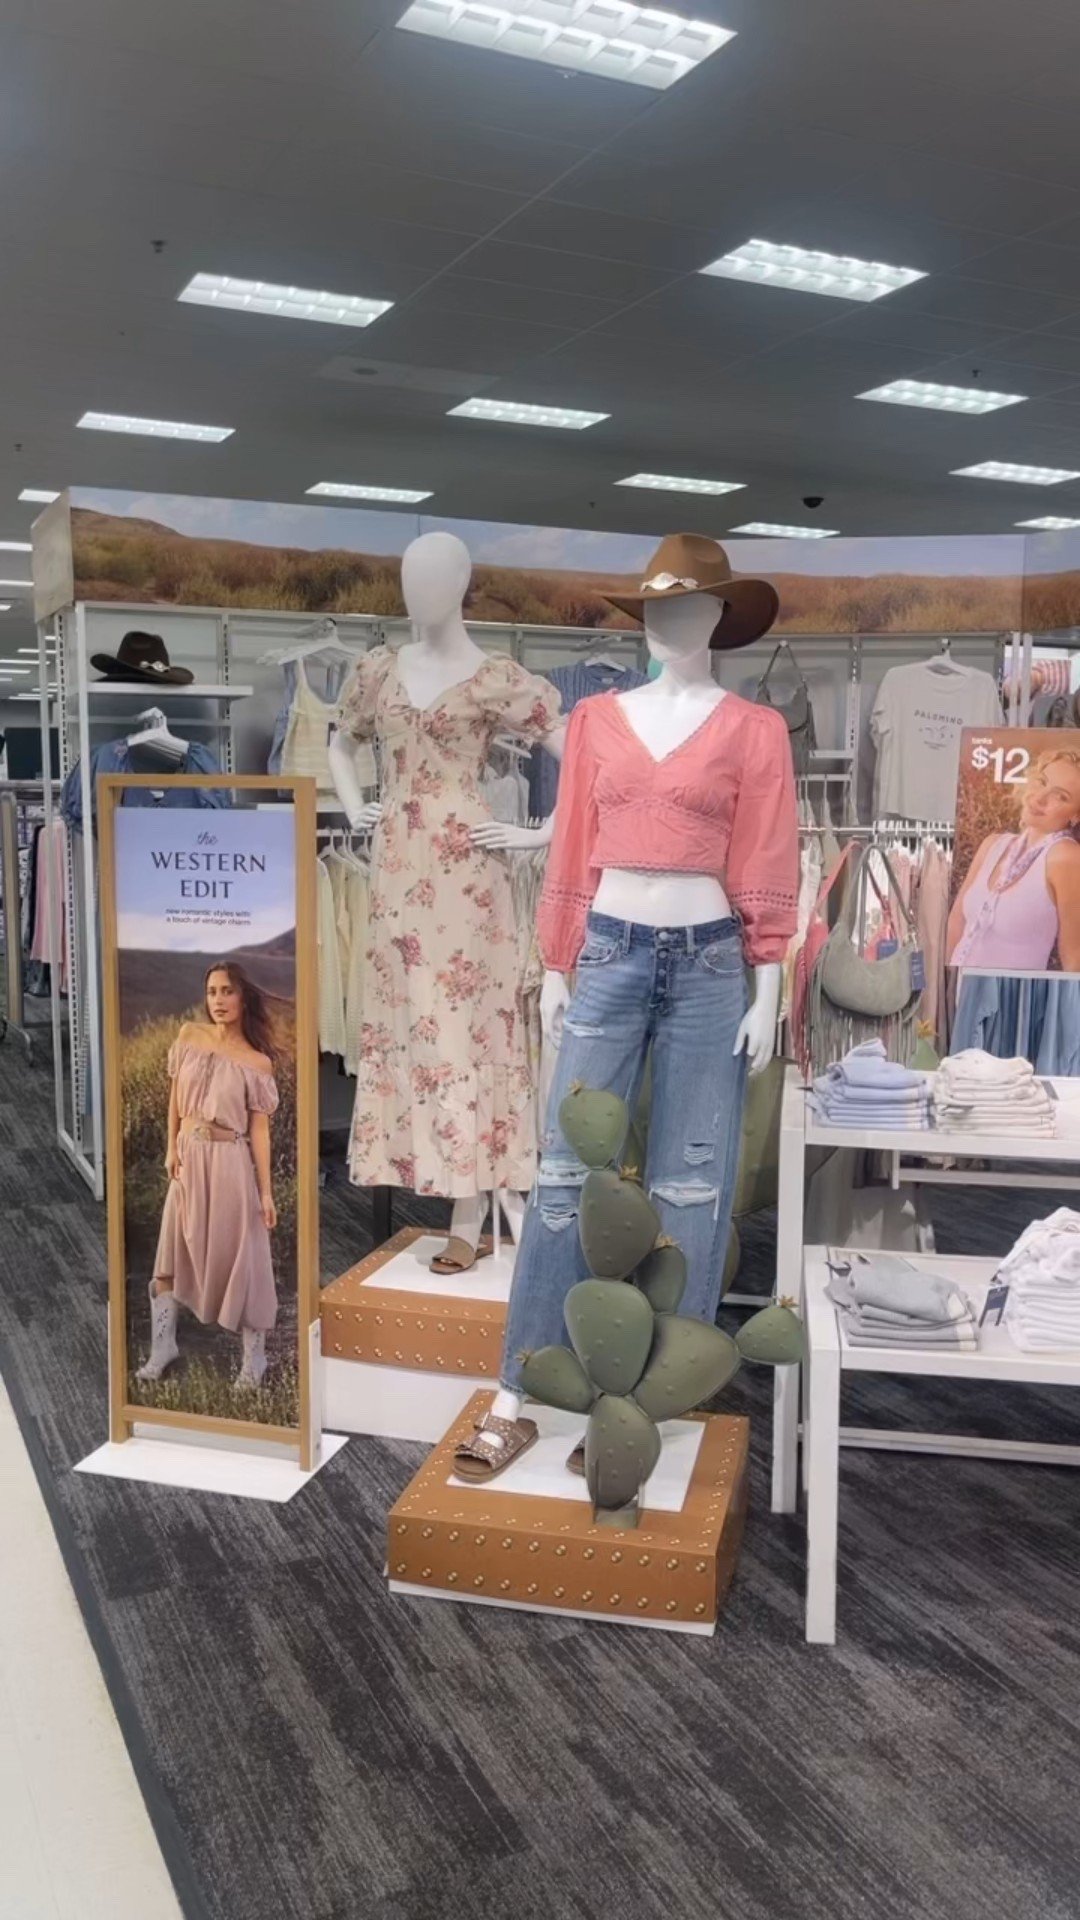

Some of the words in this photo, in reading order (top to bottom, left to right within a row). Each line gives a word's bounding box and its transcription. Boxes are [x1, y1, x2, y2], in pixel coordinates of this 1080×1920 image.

[914, 709, 963, 725] PALOMINO
[971, 745, 1030, 783] $12
[197, 831, 218, 845] the
[151, 851, 265, 873] WESTERN
[181, 880, 233, 898] EDIT
[202, 917, 226, 926] vintage
[213, 910, 234, 918] styles
